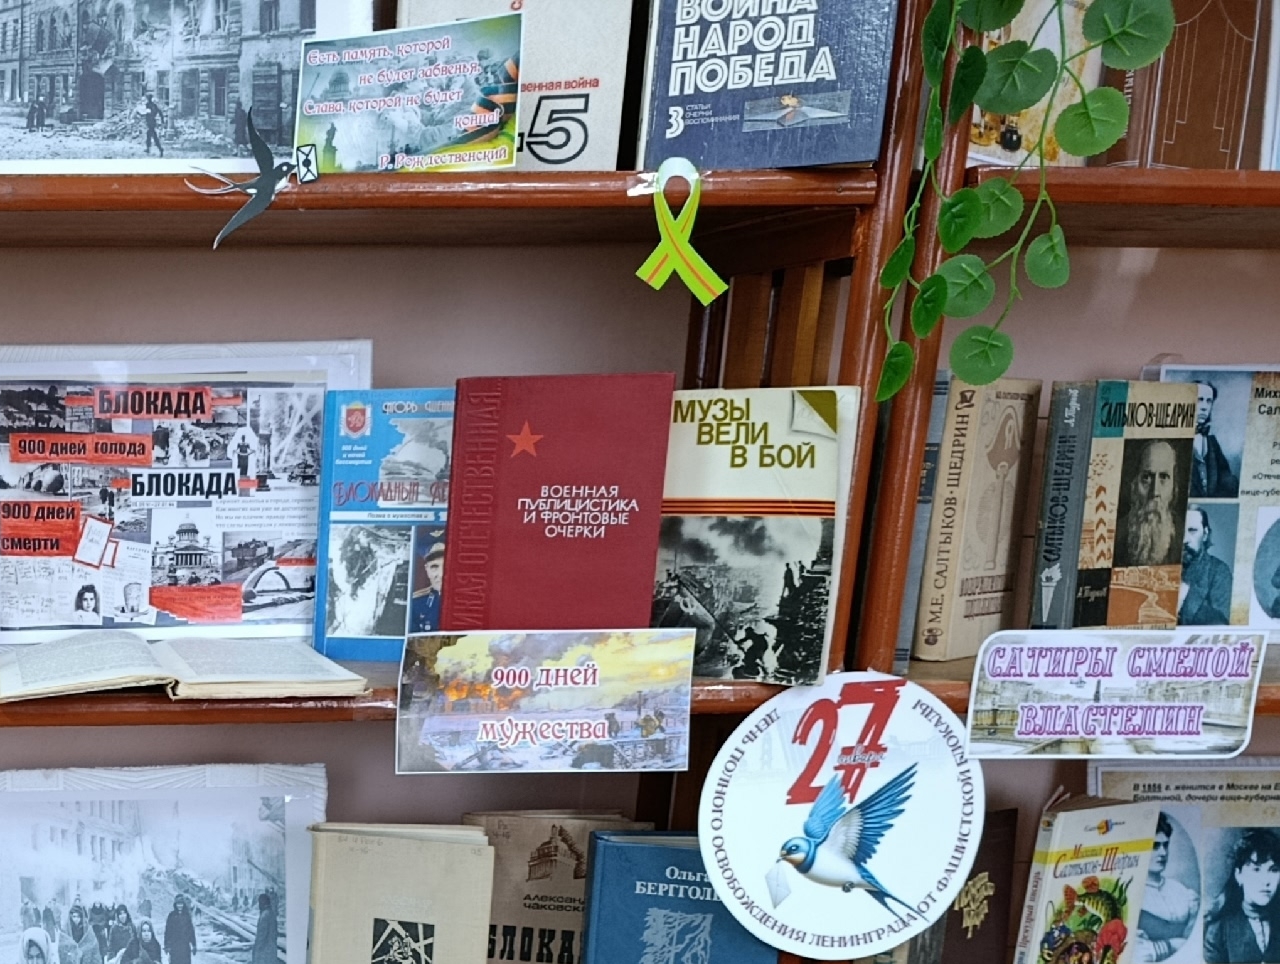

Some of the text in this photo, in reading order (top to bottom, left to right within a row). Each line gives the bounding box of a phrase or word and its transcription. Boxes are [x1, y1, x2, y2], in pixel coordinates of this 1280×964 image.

[342, 45, 393, 63] память,
[396, 36, 450, 57] которой
[672, 14, 815, 61] НАРОД
[376, 66, 414, 84] будет
[564, 77, 599, 91] война
[668, 46, 837, 97] ПОБЕДА
[303, 88, 463, 116] Слава, которой будет
[453, 109, 501, 128] конца!
[665, 106, 685, 139] 3
[394, 146, 508, 170] Рождественский
[98, 389, 207, 418] БЛОКАДА
[673, 398, 750, 423] МУЗЫ
[1100, 402, 1197, 430] САЛТЫКОВ-ЩЕДРИН
[696, 422, 770, 446] ВЕЛИ
[18, 439, 147, 458] 900 дней голода
[729, 441, 816, 469] В БОЙ
[131, 471, 238, 499] БЛОКАДА
[540, 484, 619, 499] ВОЕННАЯ
[1, 502, 76, 522] 900 дней
[517, 498, 640, 512] ПУБЛИЦИСТИКА
[523, 511, 630, 526] И ФРОНТОВЫЕ
[0, 534, 61, 553] смерти
[544, 525, 606, 539] ОЧЕРКИ
[986, 641, 1254, 679] САТИРЫ СМЕЛОЙ
[491, 663, 598, 689] 900 дней
[477, 718, 609, 748] мужества
[1016, 703, 1205, 737] ВЛАСТЕЛИН
[786, 679, 908, 806] 27
[710, 699, 974, 949] ДЕНЬ ПОЛНОГО ОСВОБОЖДЕНИЯ ЛЕНИНГРАДА ОТ ФАШИСТСКОЙ БЛОКАДЫ
[634, 881, 721, 901] БЕРГГОЛ
